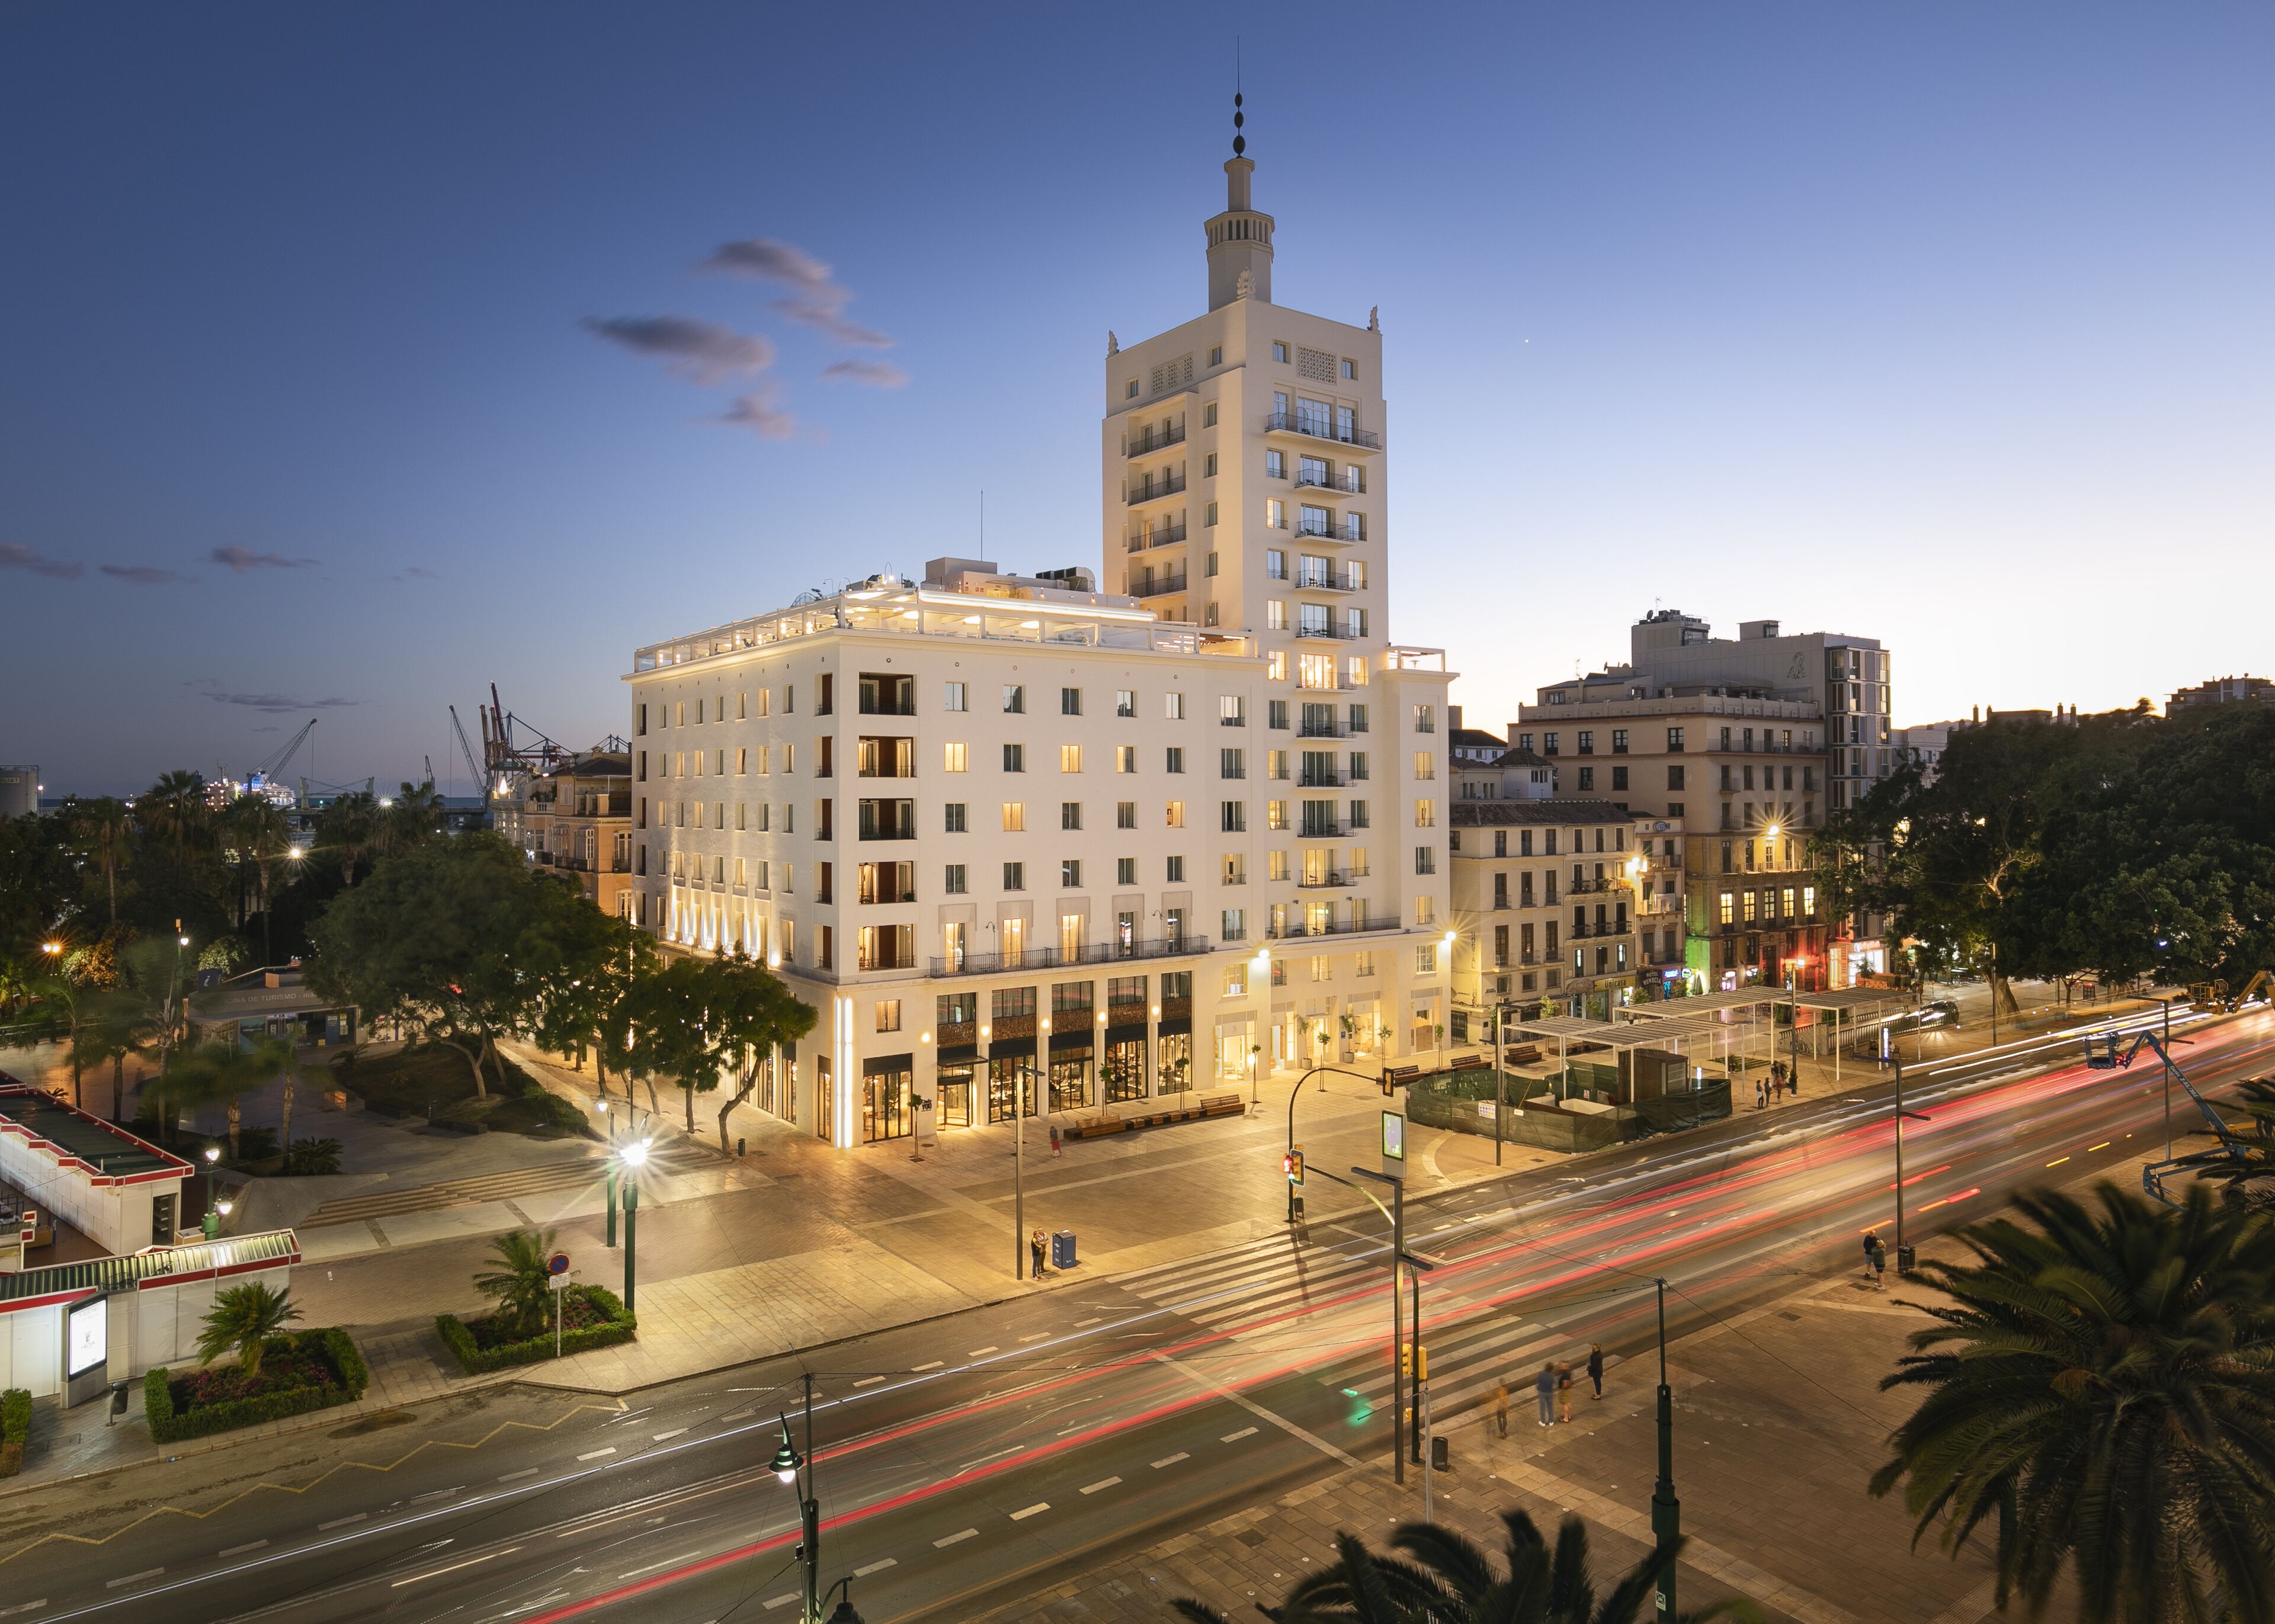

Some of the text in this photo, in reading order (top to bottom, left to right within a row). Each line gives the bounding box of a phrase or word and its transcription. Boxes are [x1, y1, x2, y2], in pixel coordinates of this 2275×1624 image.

[1604, 979, 1626, 988] Unicasa
[1643, 977, 1661, 986] VENECIA
[262, 993, 296, 1002] TURISMO
